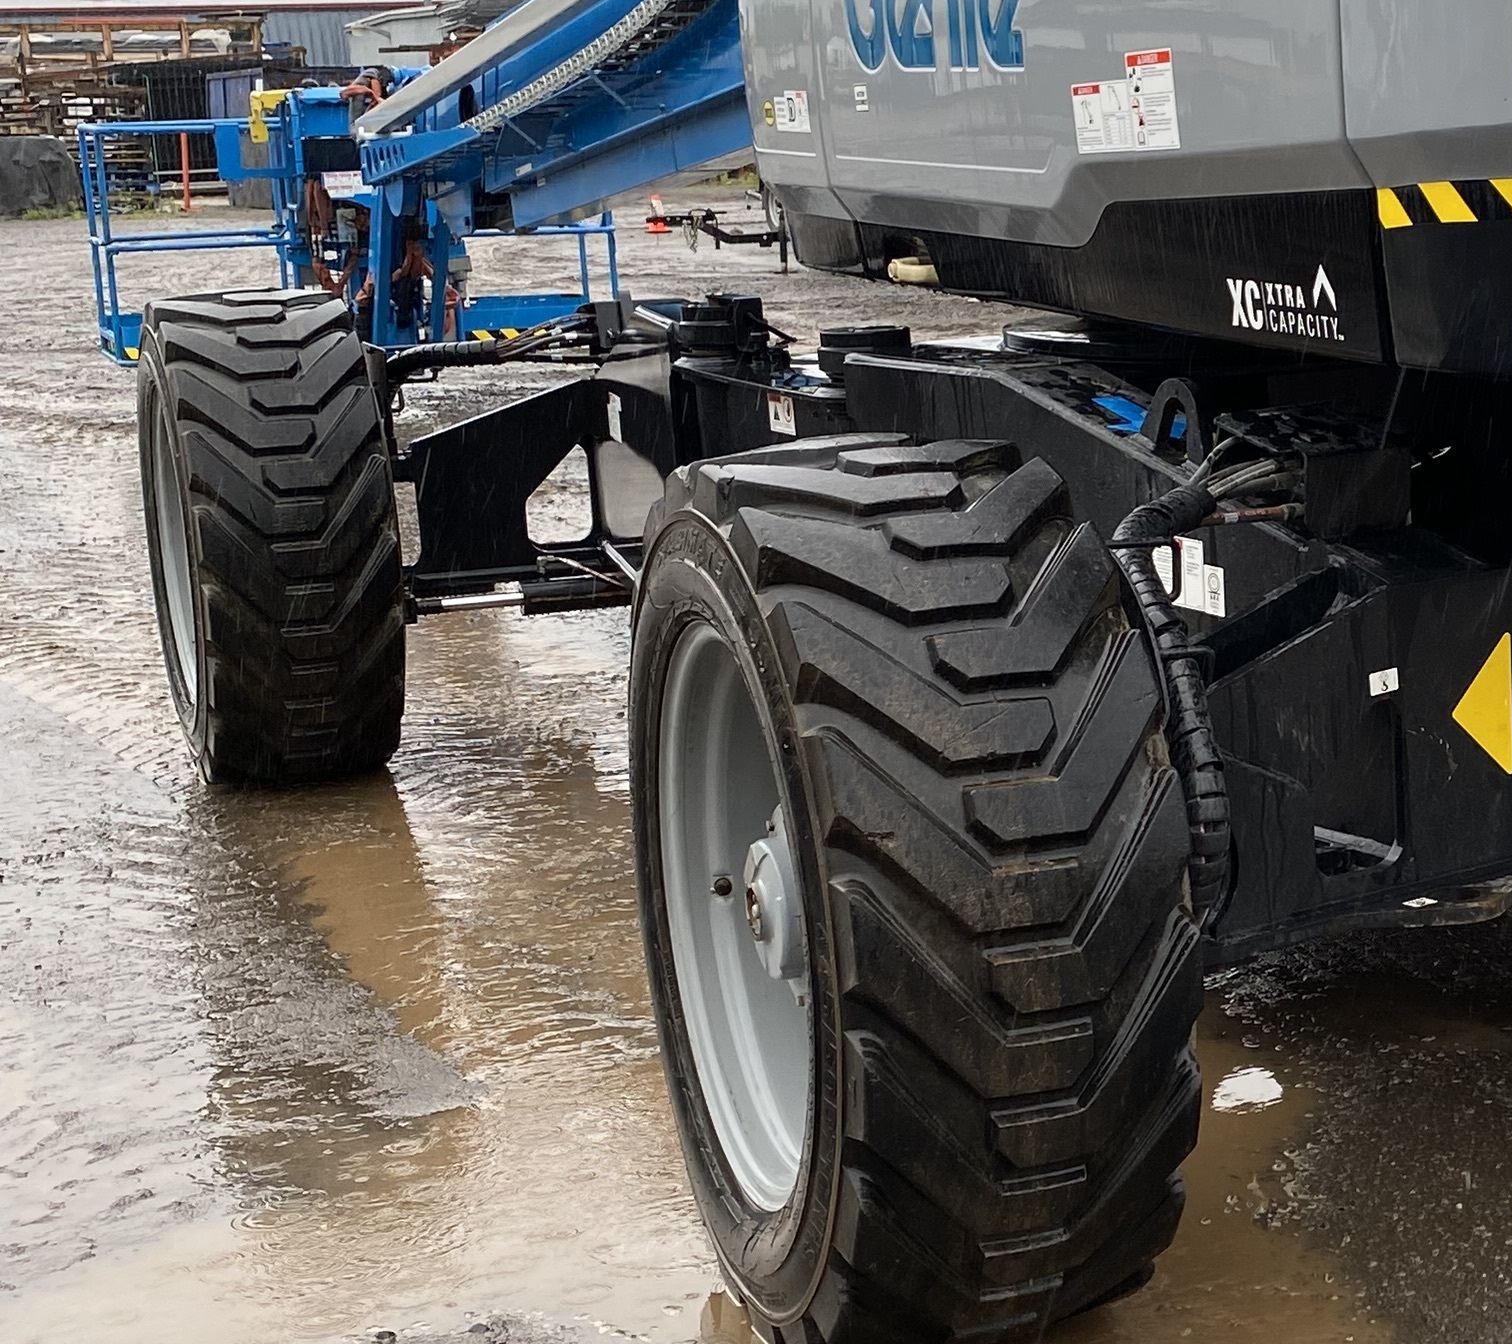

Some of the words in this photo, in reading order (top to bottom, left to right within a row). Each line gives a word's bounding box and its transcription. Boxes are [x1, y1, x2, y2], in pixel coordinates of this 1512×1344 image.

[1226, 278, 1264, 330] XC
[1265, 282, 1306, 308] XTRA
[1269, 309, 1338, 340] CAPACITY
